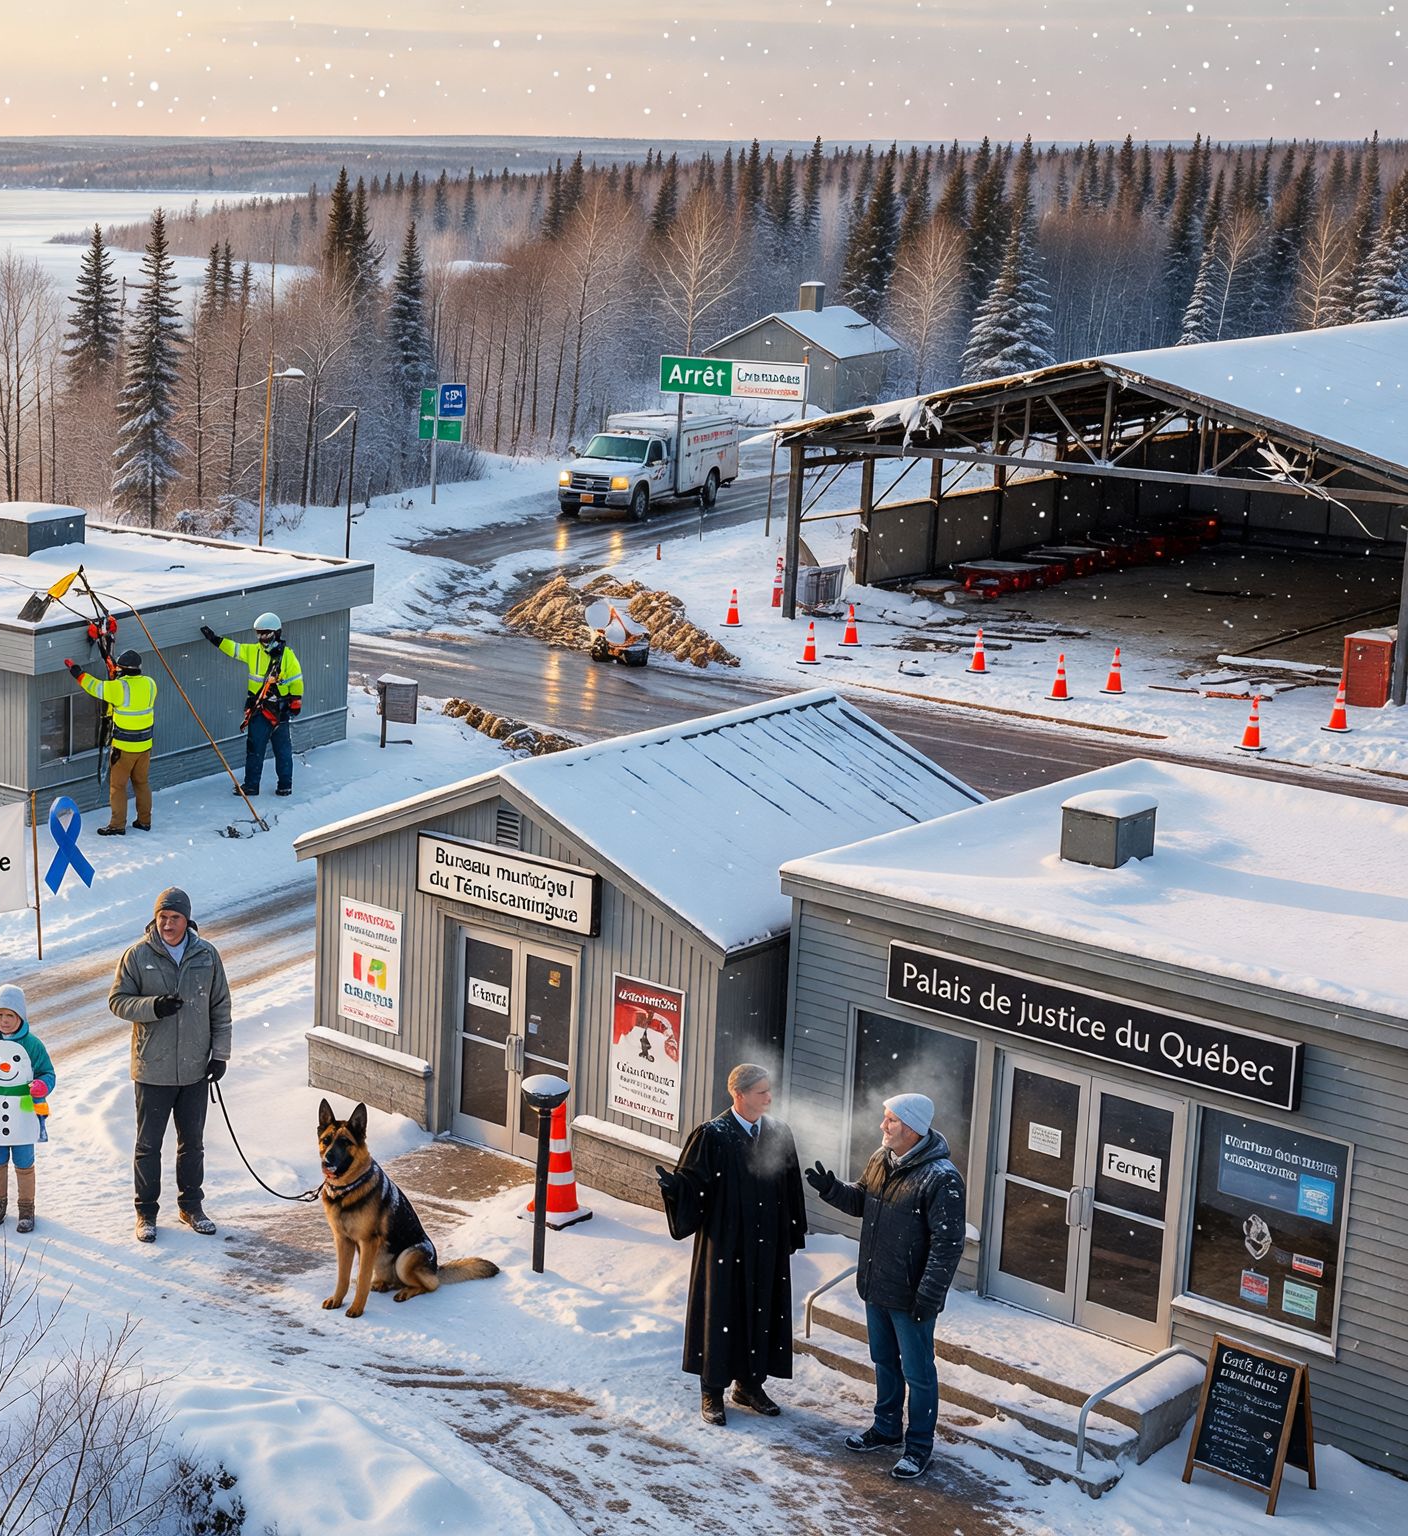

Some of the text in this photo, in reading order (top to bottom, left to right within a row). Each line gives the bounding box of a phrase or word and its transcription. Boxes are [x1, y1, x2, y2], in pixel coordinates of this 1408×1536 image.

[668, 364, 725, 387] Arrêt
[435, 846, 490, 877] Bureau
[429, 870, 450, 890] du
[902, 961, 1274, 1086] Palais de justice du Québec
[1108, 1152, 1156, 1184] Fermé
